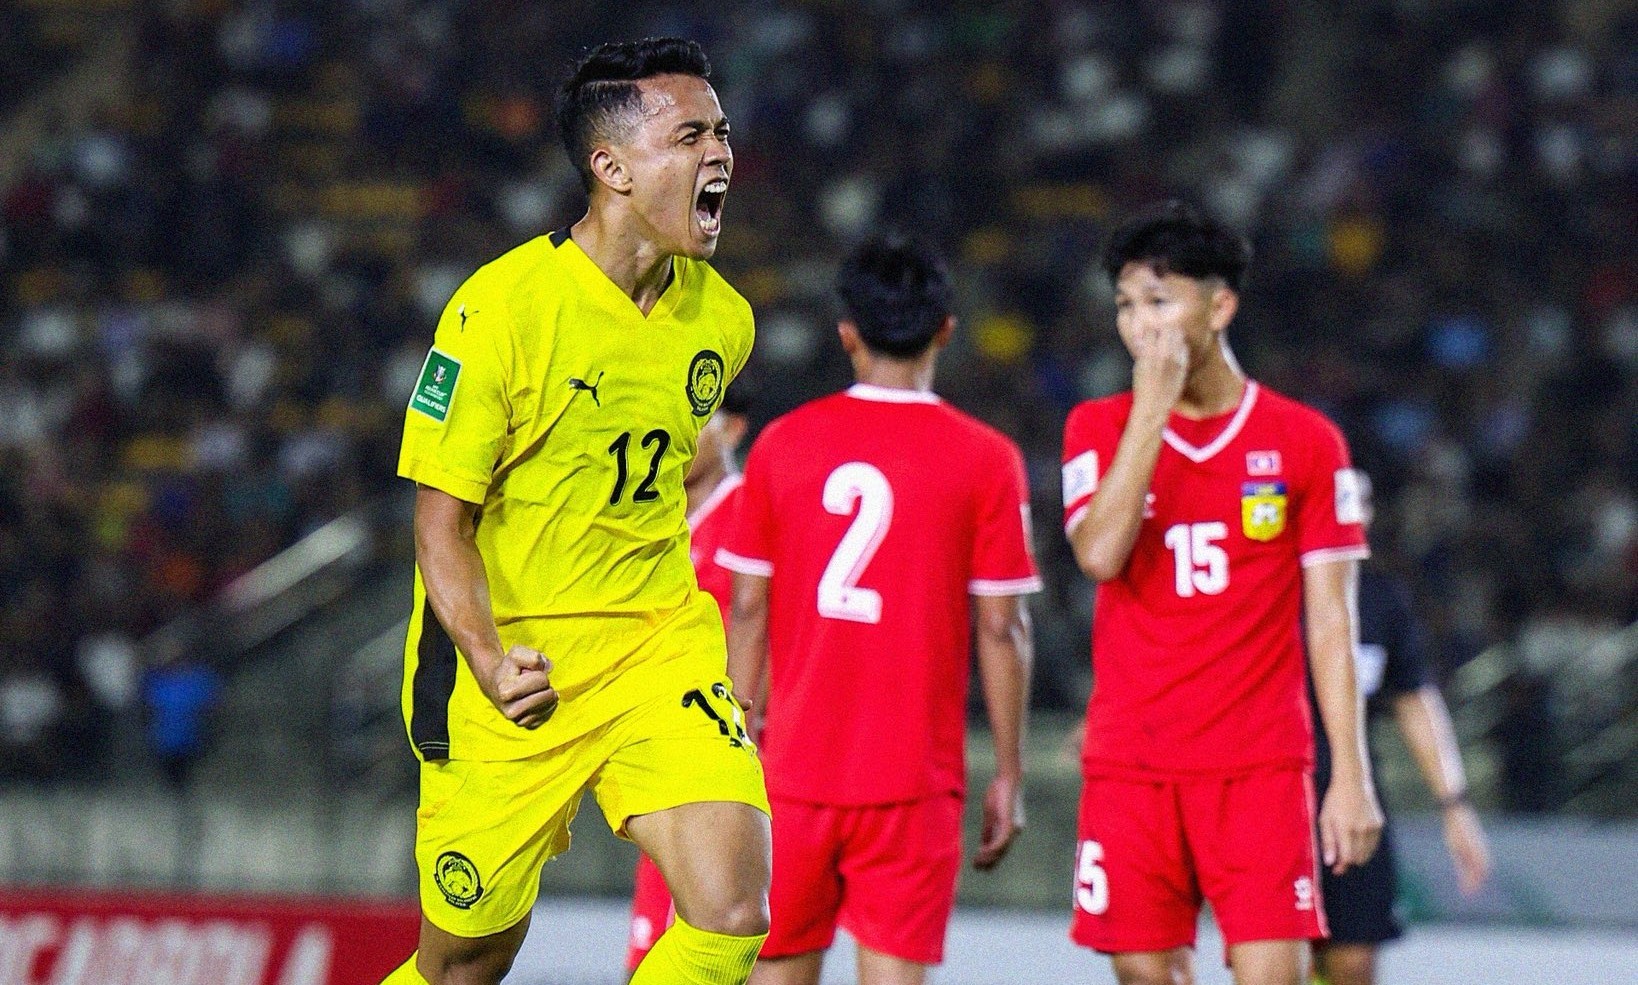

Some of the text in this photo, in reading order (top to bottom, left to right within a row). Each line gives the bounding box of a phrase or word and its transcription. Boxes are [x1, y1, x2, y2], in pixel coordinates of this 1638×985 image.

[416, 394, 446, 413] QUALIFIERS
[608, 428, 671, 506] 12
[818, 460, 894, 624] 2
[1164, 521, 1229, 597] 15
